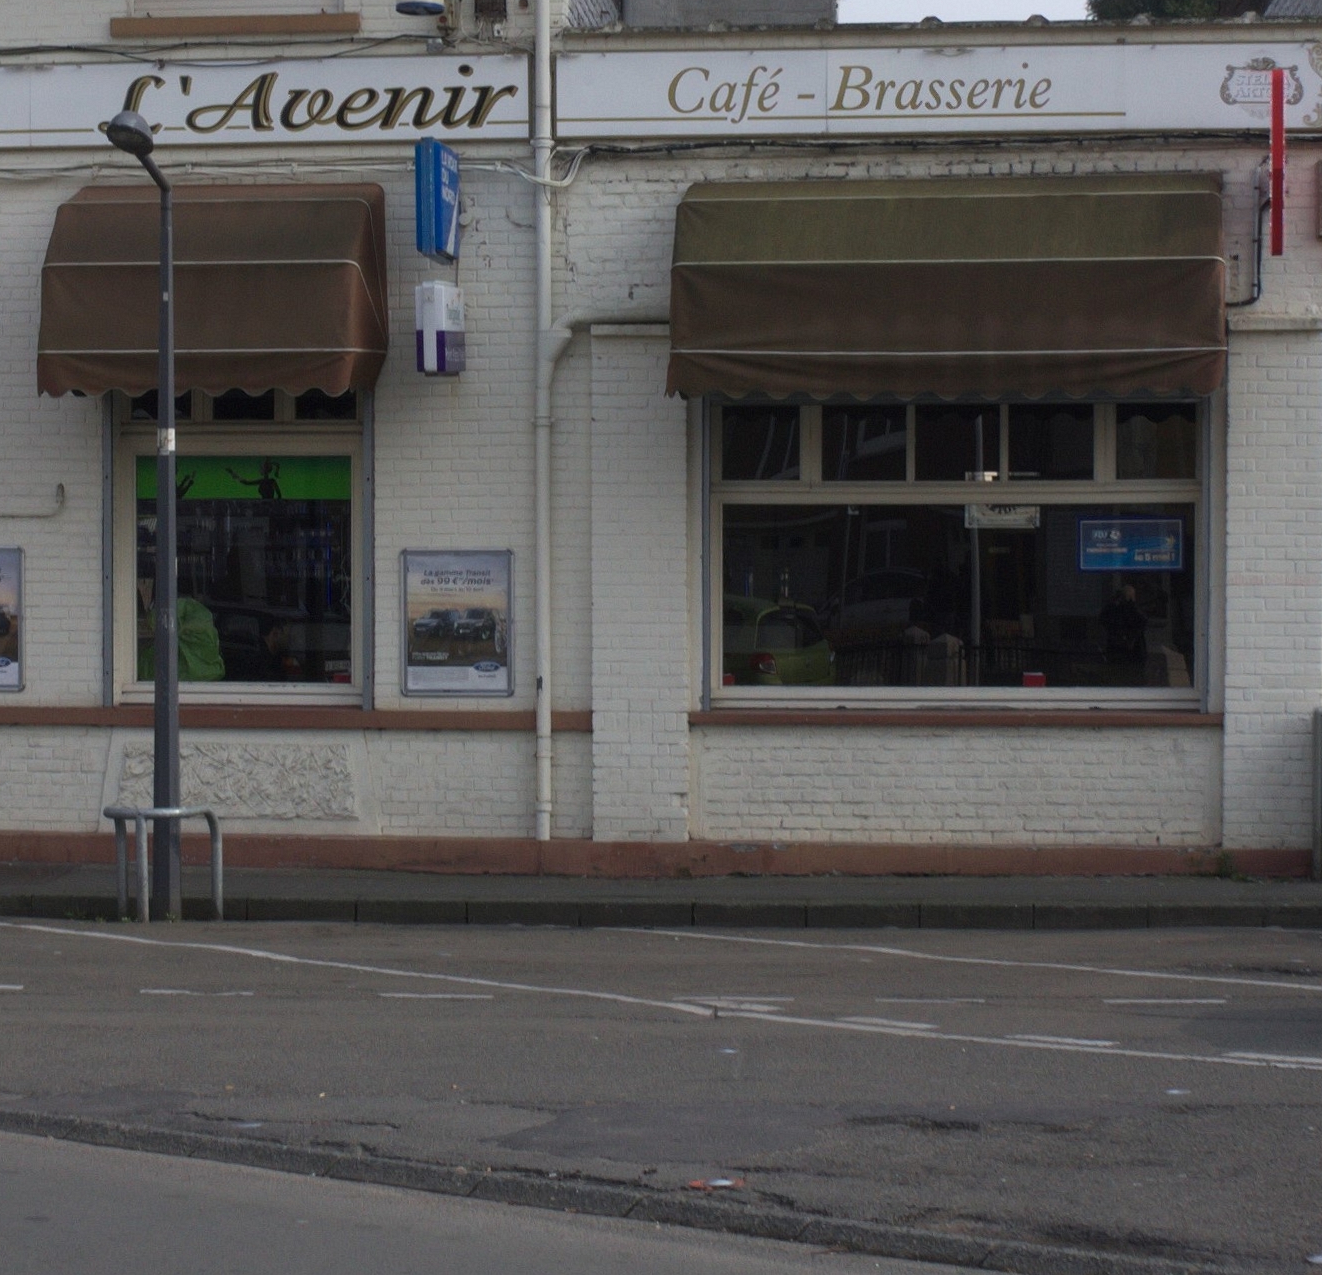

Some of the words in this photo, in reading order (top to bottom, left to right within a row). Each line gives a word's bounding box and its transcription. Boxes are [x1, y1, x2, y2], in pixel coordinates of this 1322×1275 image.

[100, 65, 516, 134] L'Avenir
[667, 65, 784, 124] Café
[829, 62, 1053, 111] Brasserie
